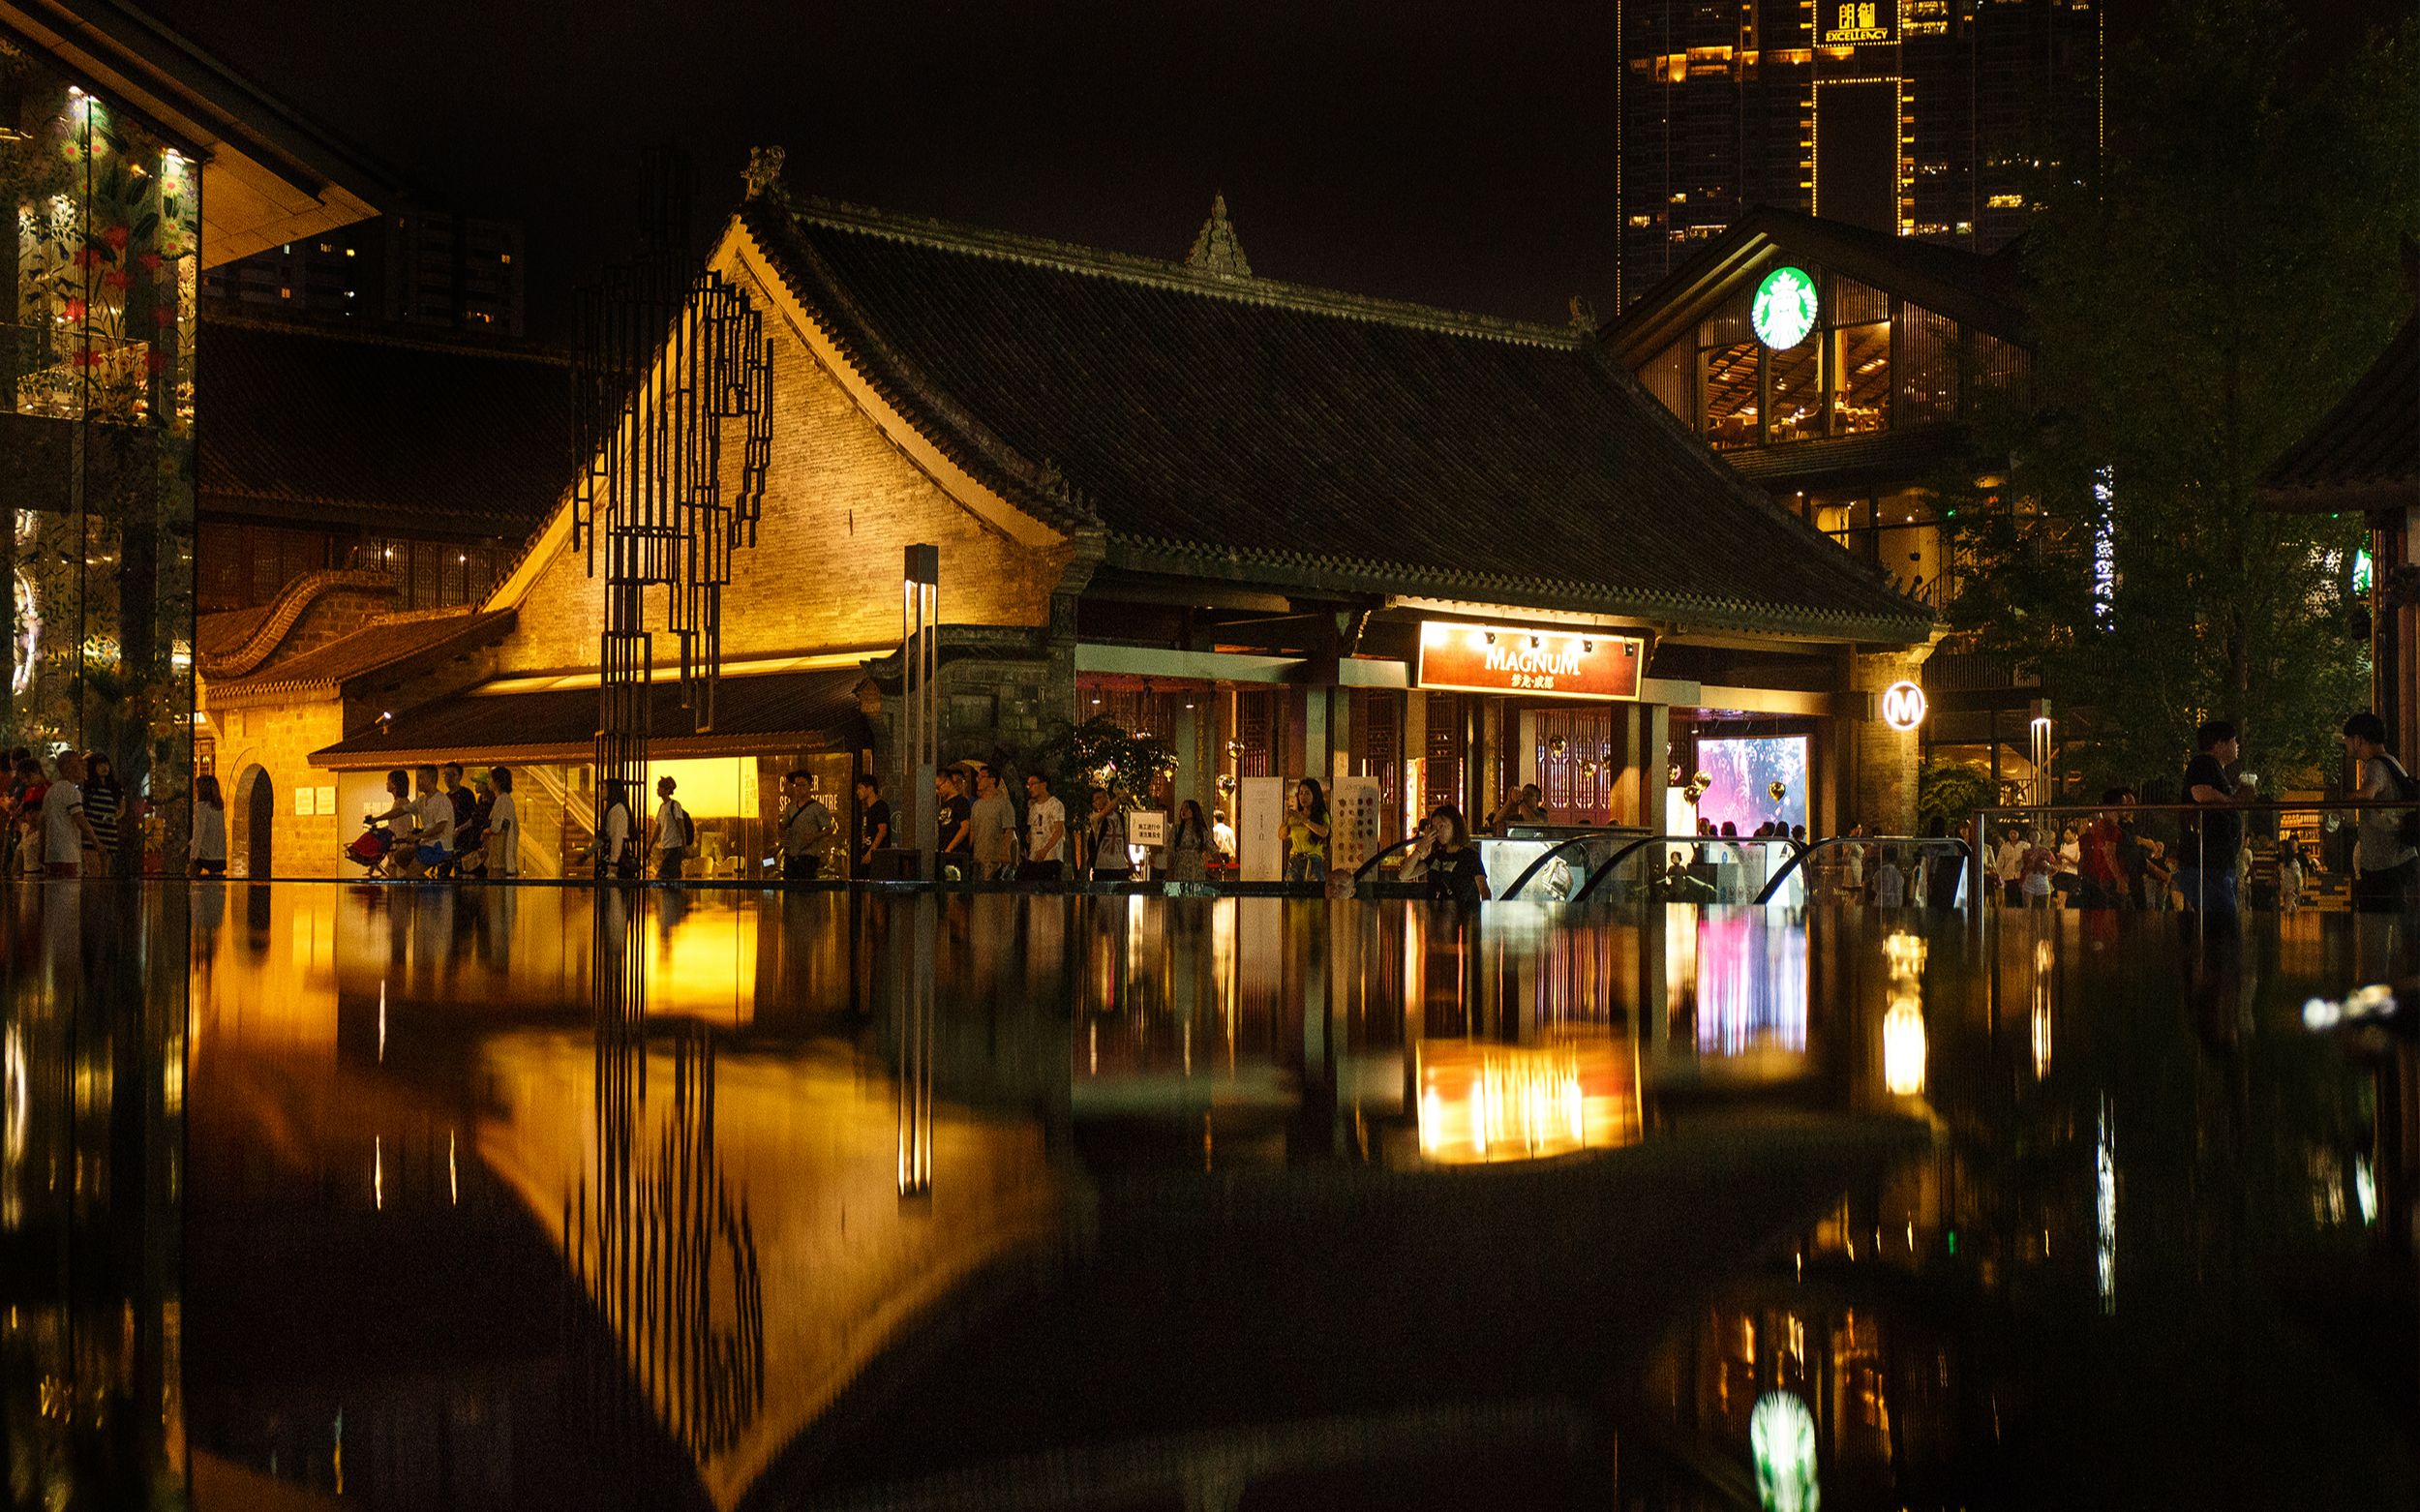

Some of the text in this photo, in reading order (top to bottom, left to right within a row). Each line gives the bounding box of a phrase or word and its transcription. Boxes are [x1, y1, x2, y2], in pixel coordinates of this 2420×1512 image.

[1826, 30, 1889, 43] EXCELLENCY
[1484, 647, 1582, 676] MAGNUM
[1890, 689, 1920, 724] M
